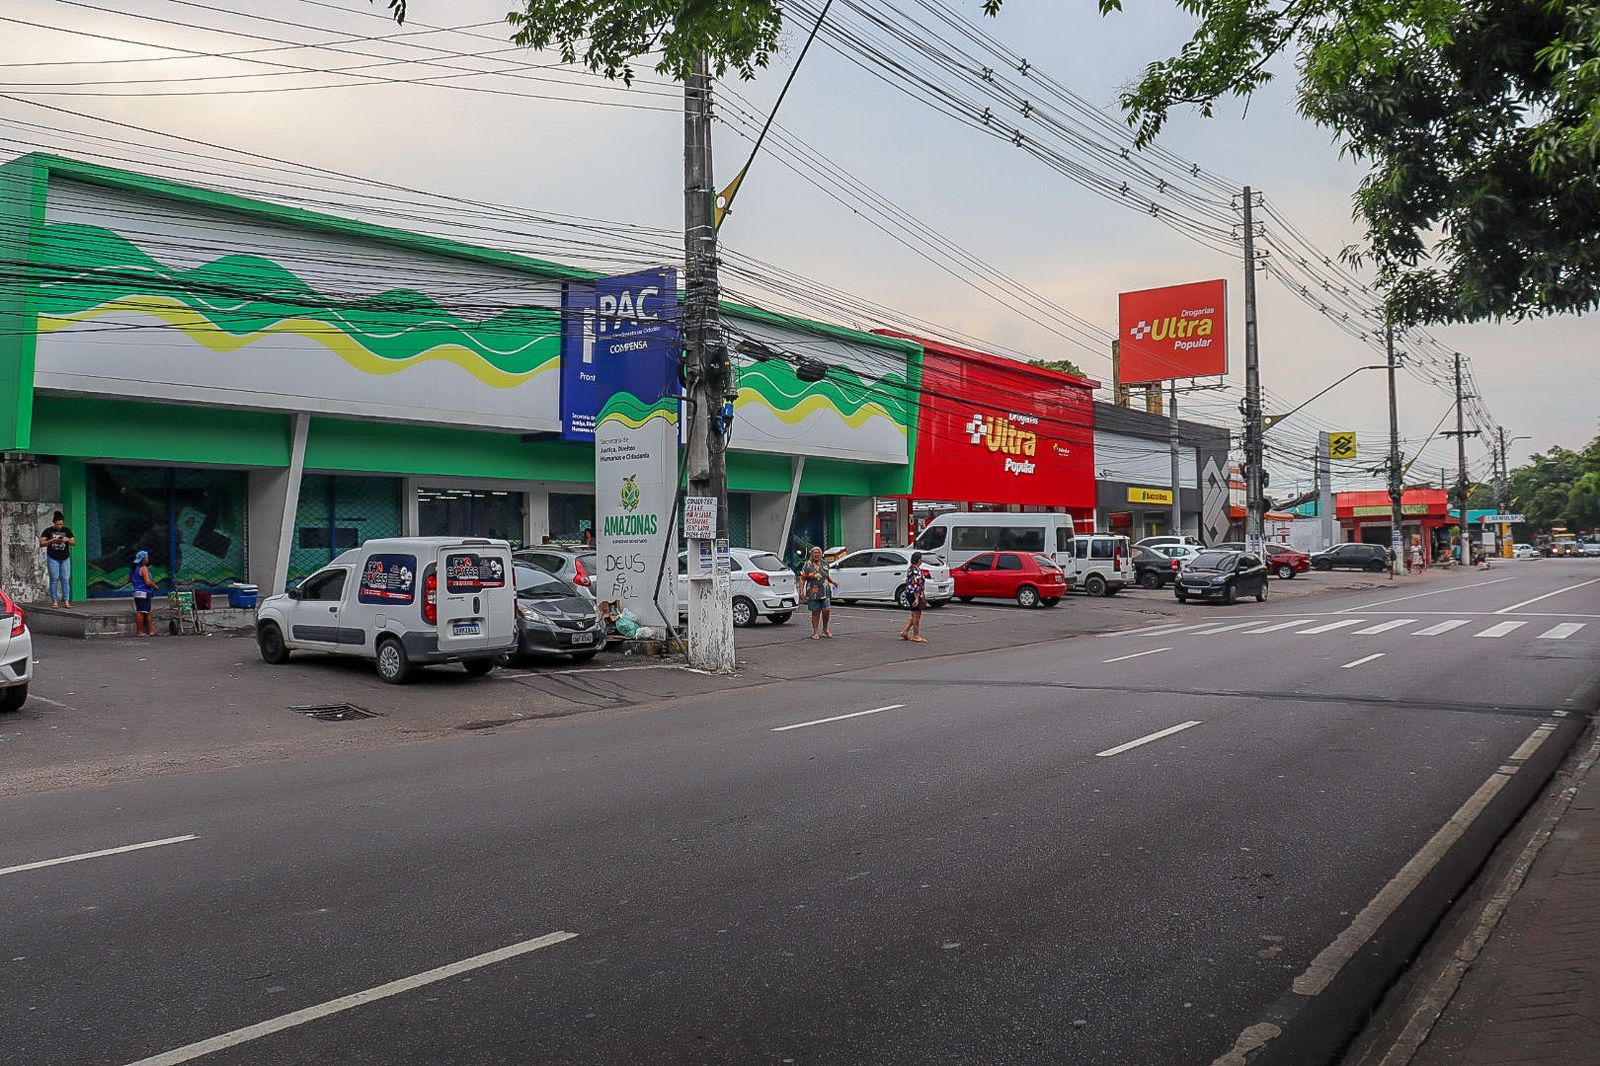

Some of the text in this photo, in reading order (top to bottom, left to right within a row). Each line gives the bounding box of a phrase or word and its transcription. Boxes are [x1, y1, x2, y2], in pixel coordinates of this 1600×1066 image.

[600, 286, 659, 332] PAC
[1181, 306, 1215, 317] Drogarias
[1151, 316, 1213, 341] Ultra
[610, 341, 648, 354] COMPENSA
[1174, 338, 1213, 351] Popular
[986, 416, 1036, 456] Ultra
[626, 452, 650, 460] Cidadania
[1004, 457, 1036, 476] Popular
[604, 514, 657, 536] AMAZONAS
[606, 553, 646, 573] DEUS
